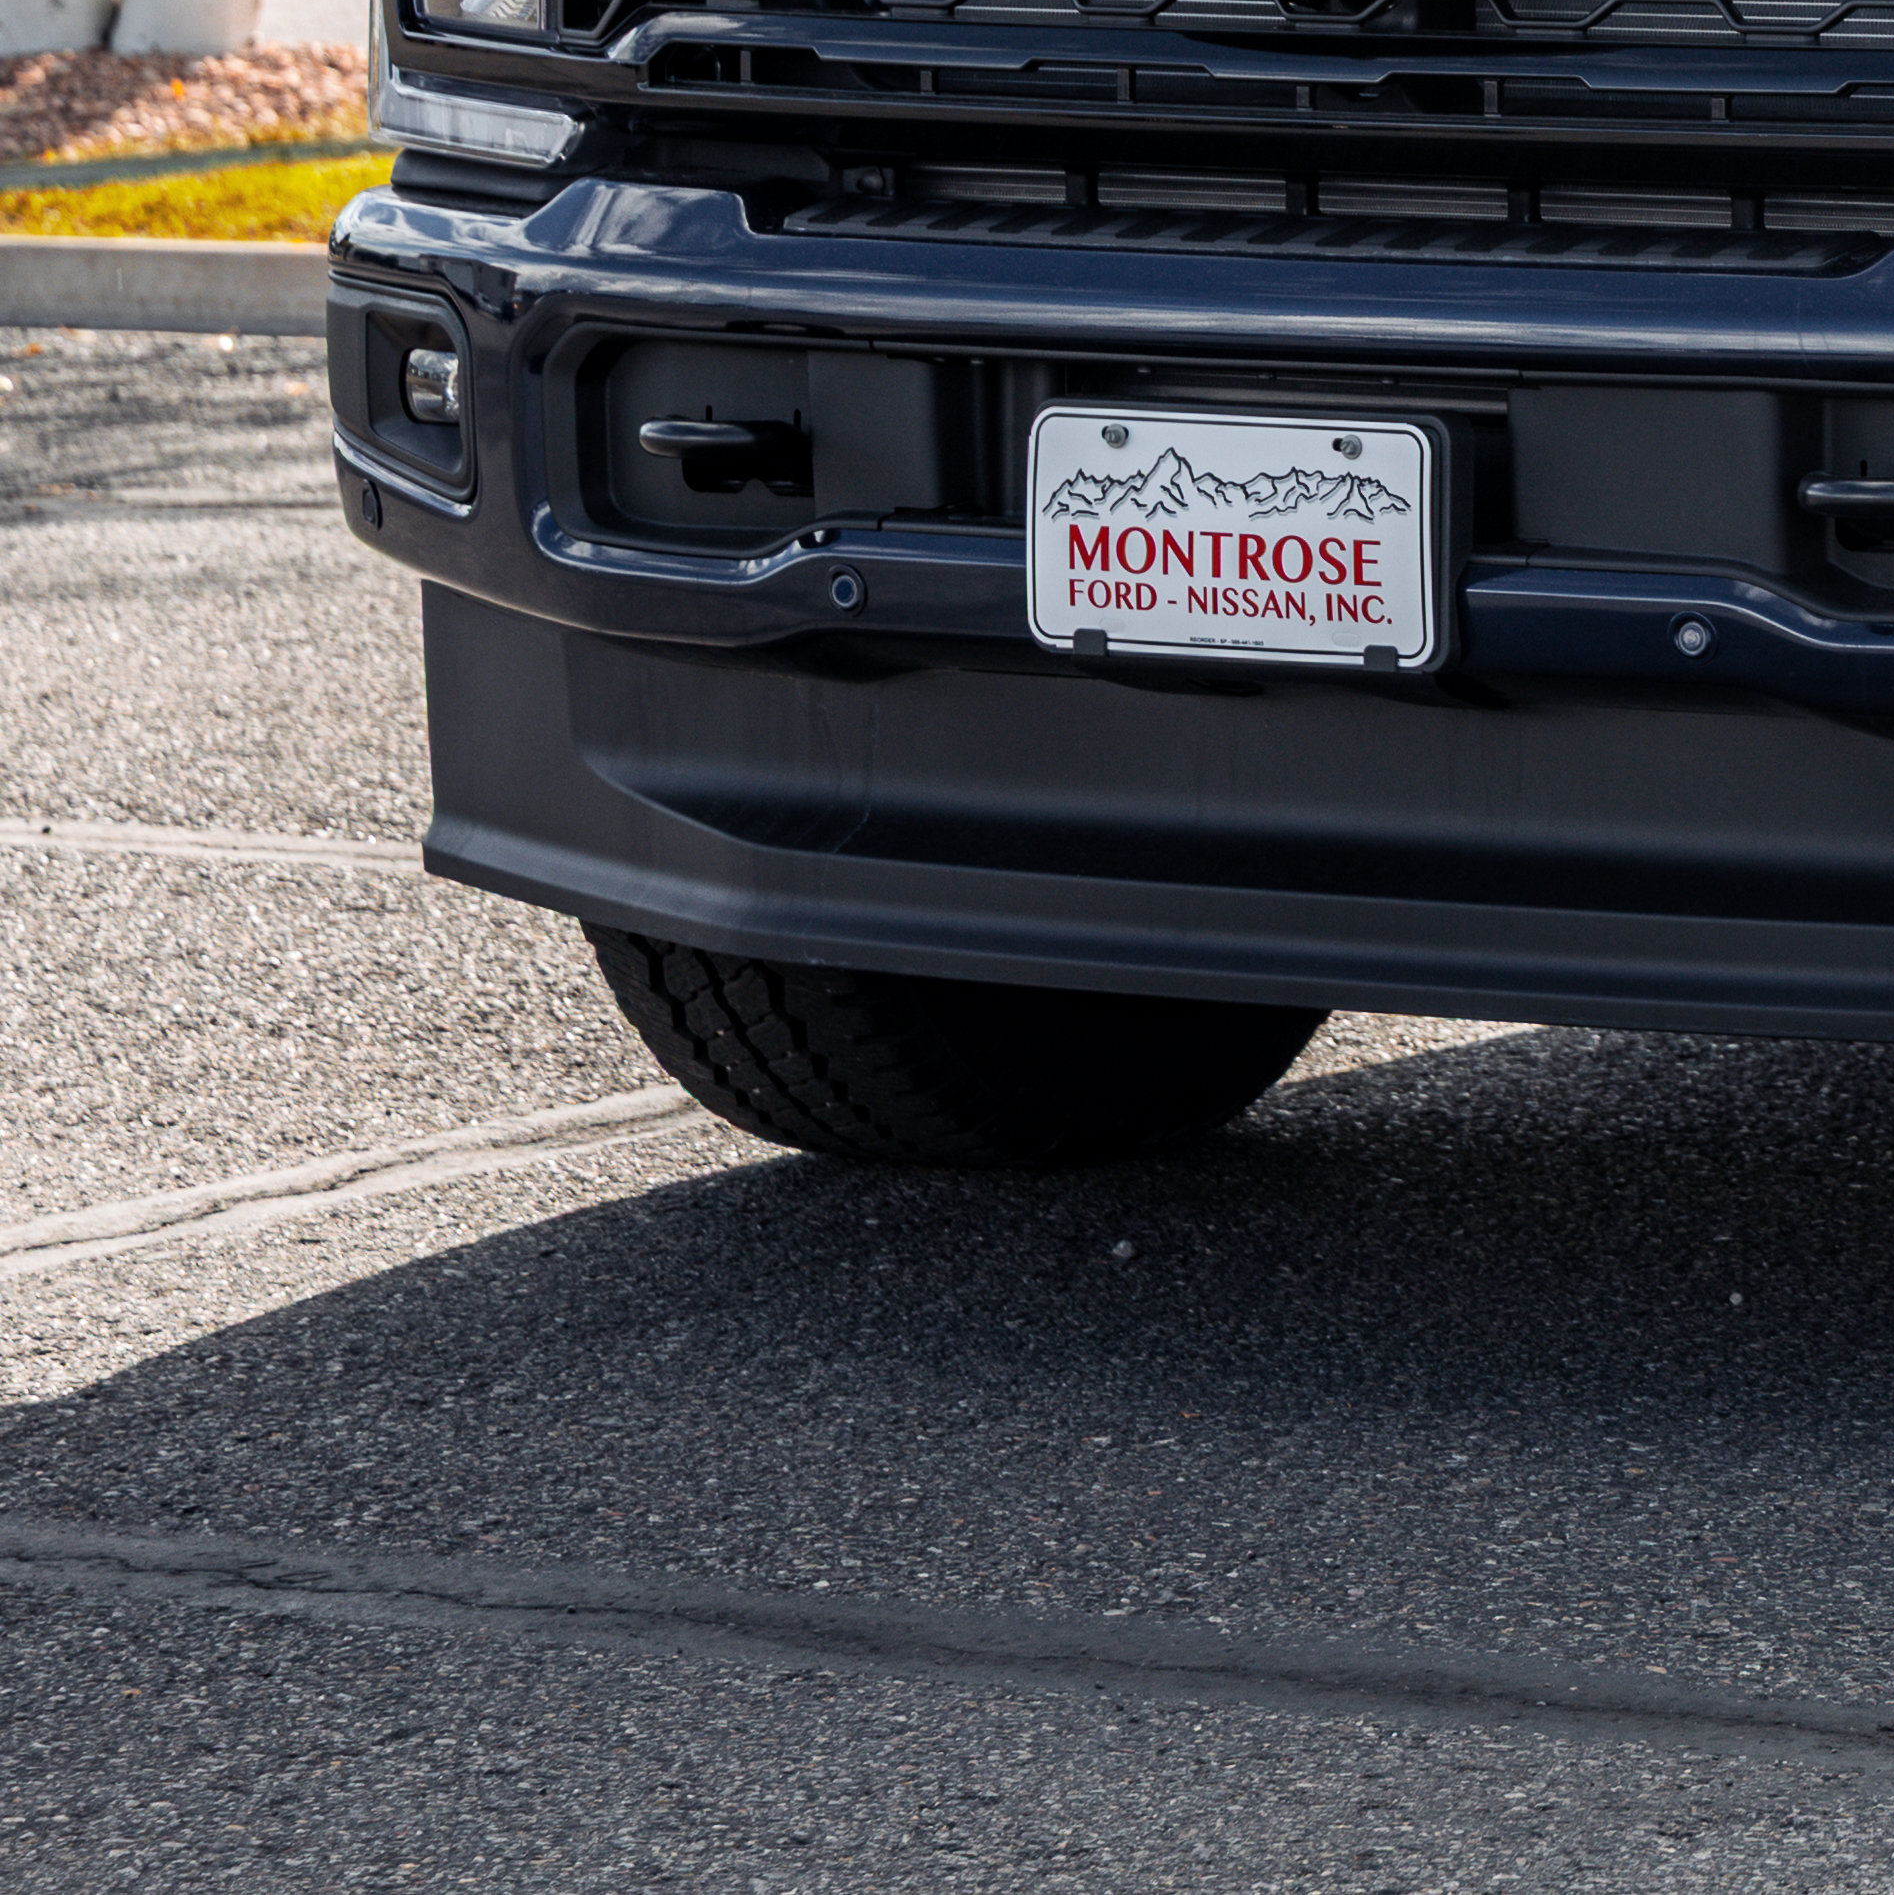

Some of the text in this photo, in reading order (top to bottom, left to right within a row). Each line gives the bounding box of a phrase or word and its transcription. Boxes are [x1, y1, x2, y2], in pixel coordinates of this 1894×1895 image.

[1068, 524, 1382, 588] MONTROSE
[1068, 578, 1157, 611] FORD
[1187, 585, 1316, 626] NISSAN,
[1325, 593, 1393, 625] INC.
